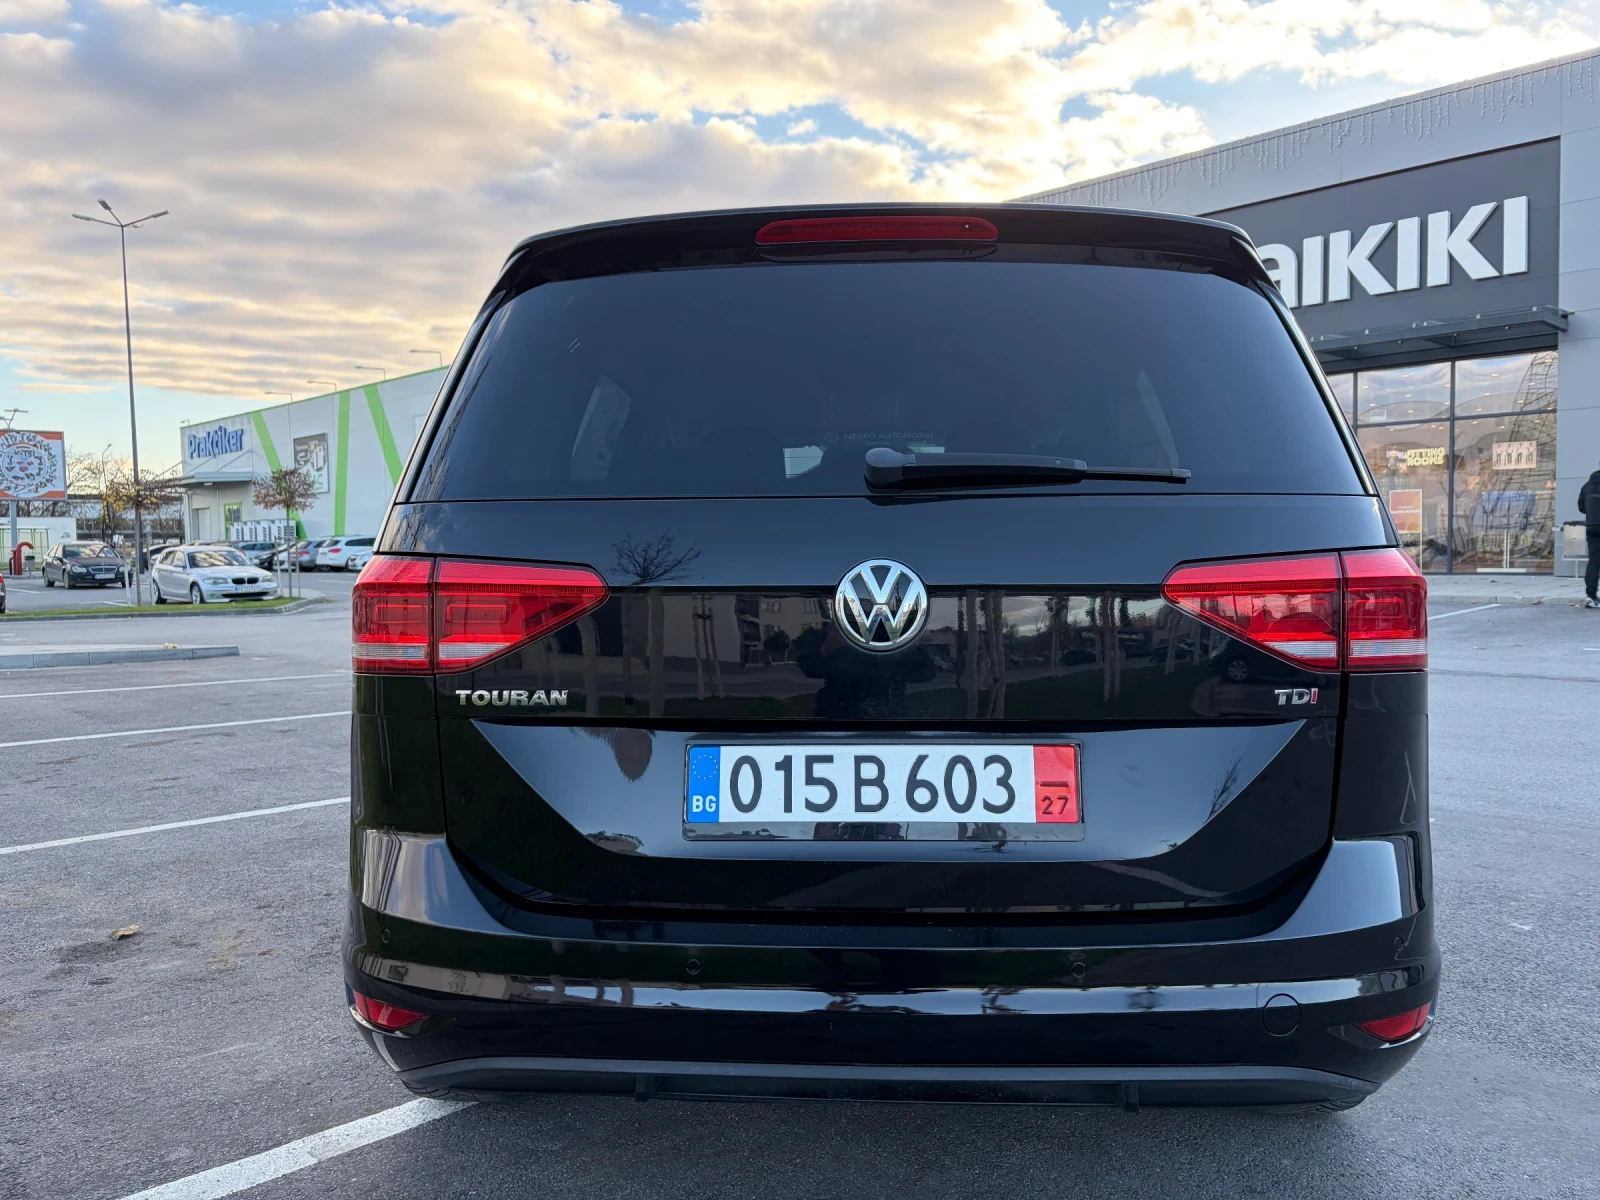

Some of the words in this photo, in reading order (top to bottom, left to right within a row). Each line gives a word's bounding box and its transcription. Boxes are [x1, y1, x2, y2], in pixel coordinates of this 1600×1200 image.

[187, 425, 244, 459] Praktiker
[844, 432, 876, 440] NEGRO
[1407, 447, 1445, 458] FITTING
[1408, 456, 1444, 467] ROOMS
[455, 689, 568, 706] TOURAN
[1274, 688, 1319, 705] TDI
[692, 795, 717, 813] BG
[1041, 795, 1069, 815] 27
